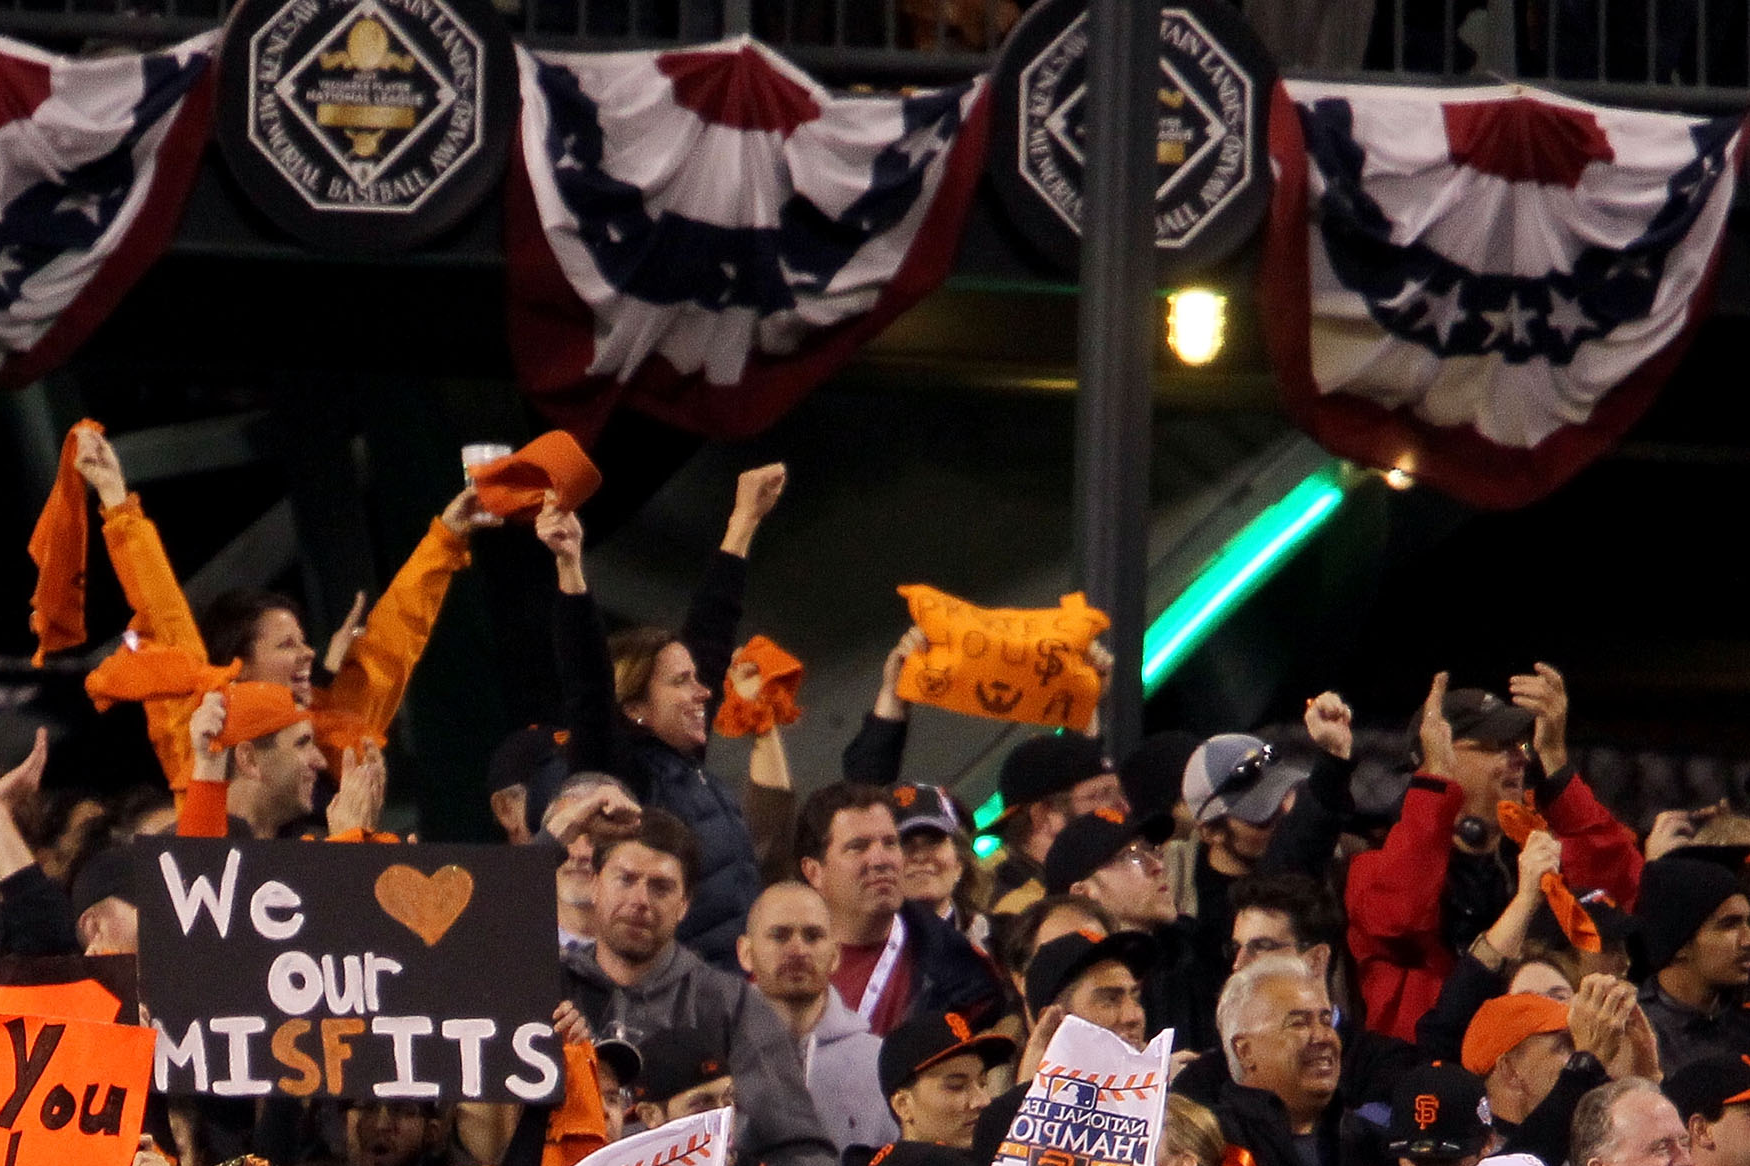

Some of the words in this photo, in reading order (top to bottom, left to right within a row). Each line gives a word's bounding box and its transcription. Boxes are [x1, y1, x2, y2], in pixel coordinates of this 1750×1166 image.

[158, 848, 305, 940] We
[268, 950, 403, 1016] our
[152, 1015, 559, 1100] MISFITS
[1415, 1095, 1440, 1130] SF
